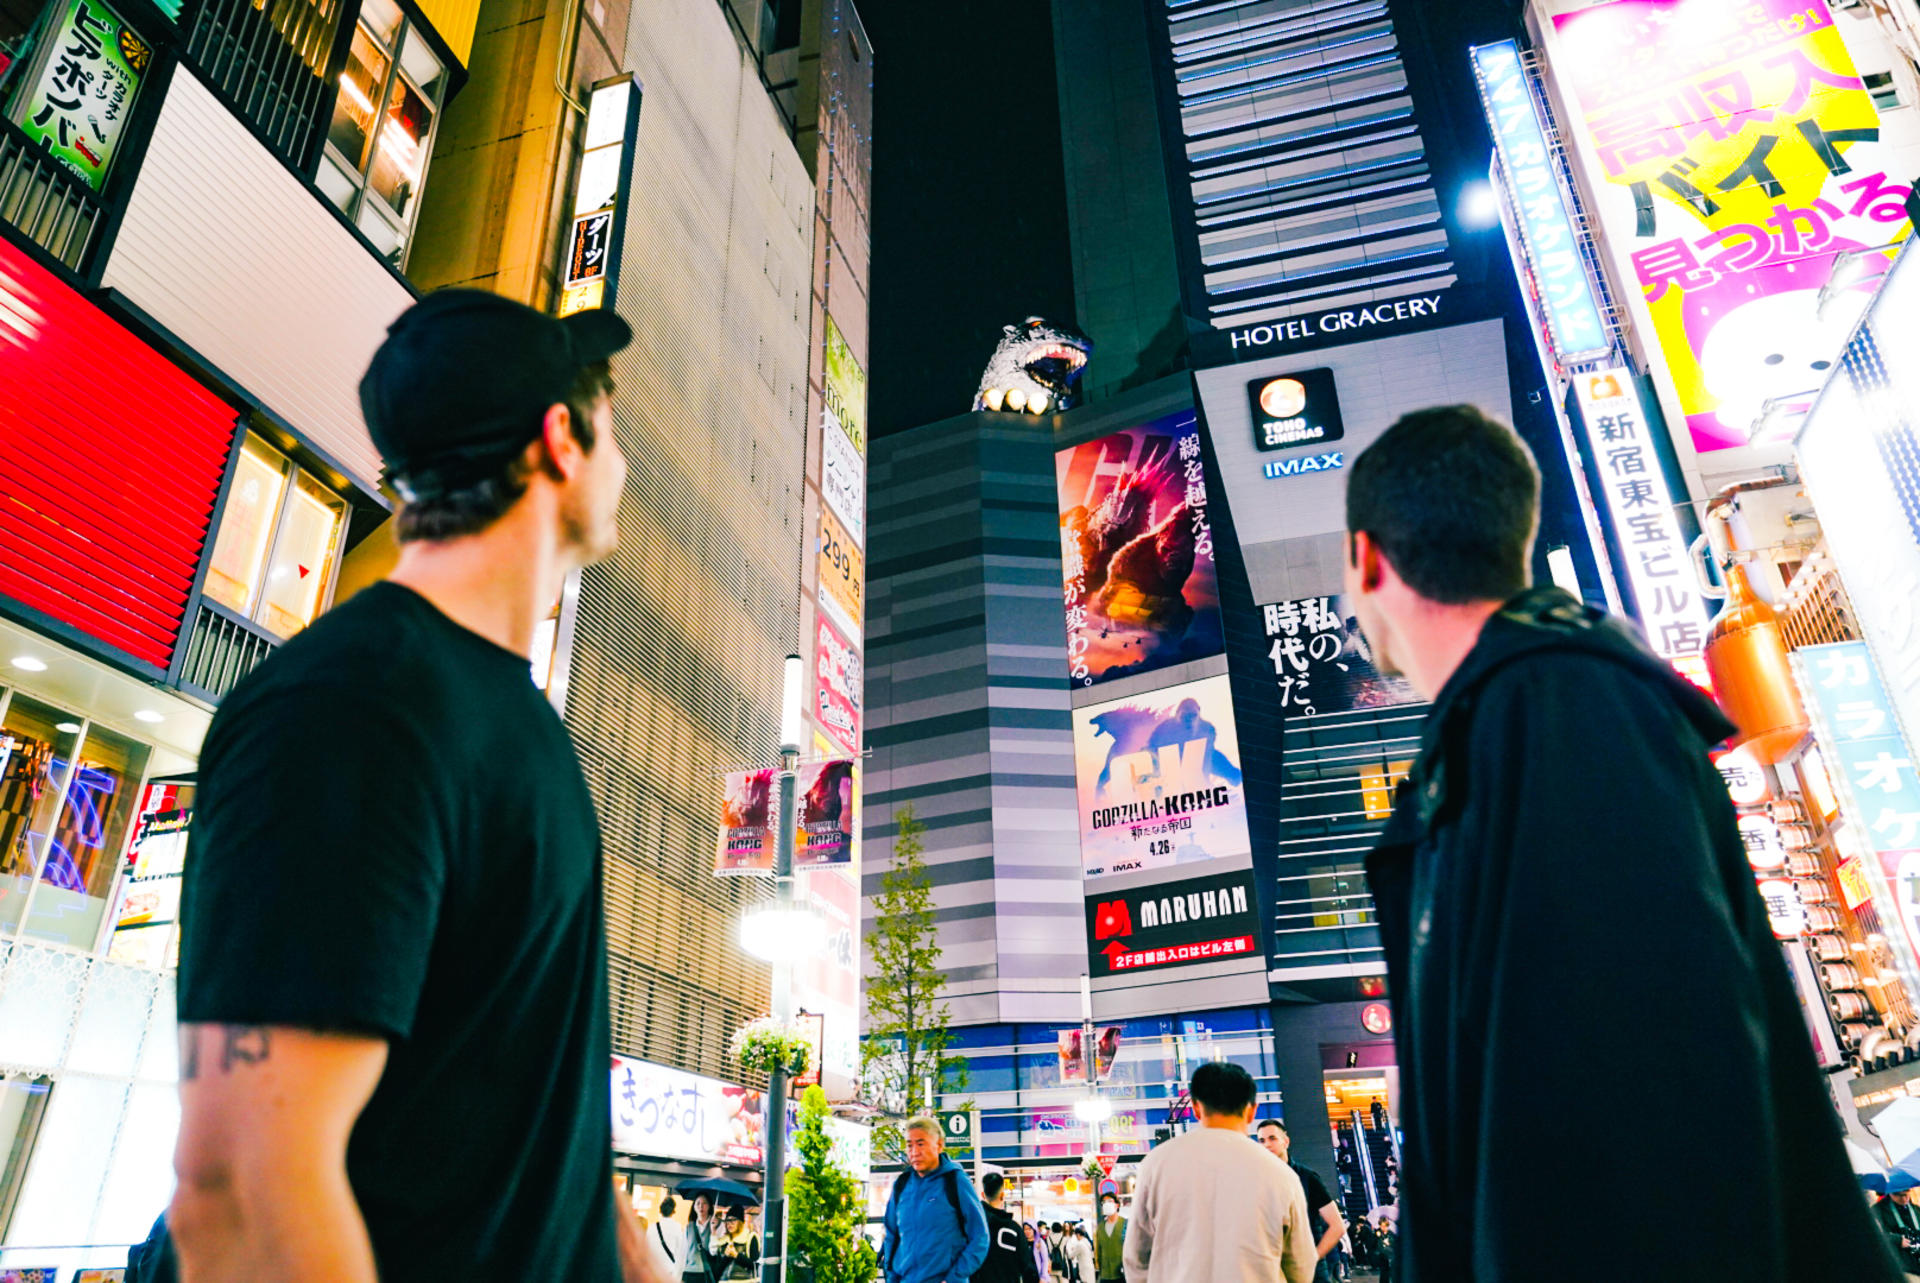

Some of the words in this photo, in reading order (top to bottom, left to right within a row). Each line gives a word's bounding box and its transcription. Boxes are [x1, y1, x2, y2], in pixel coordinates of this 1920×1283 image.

[106, 57, 132, 85] with
[105, 82, 127, 121] カラオケ
[1586, 49, 1865, 177] 高収入
[1629, 119, 1880, 237] バイト
[585, 214, 609, 266] ダーツ
[1630, 171, 1914, 304] 見つかる
[1230, 319, 1316, 349] HOTEL
[1319, 295, 1441, 332] GRACERY
[1262, 417, 1307, 435] TOHO
[1264, 426, 1324, 445] CINEMAS
[1264, 452, 1343, 478] IMAX
[822, 528, 850, 581] 299
[1595, 411, 1702, 655] 新宿東宝ビル店
[1264, 600, 1316, 716] 時代だ。
[1817, 650, 1920, 850] カラオケ
[1164, 786, 1230, 816] KONG
[727, 839, 763, 850] KONG
[1150, 840, 1170, 856] 4.26
[1113, 861, 1142, 873] IMAX
[1140, 885, 1248, 928] MARUHAN
